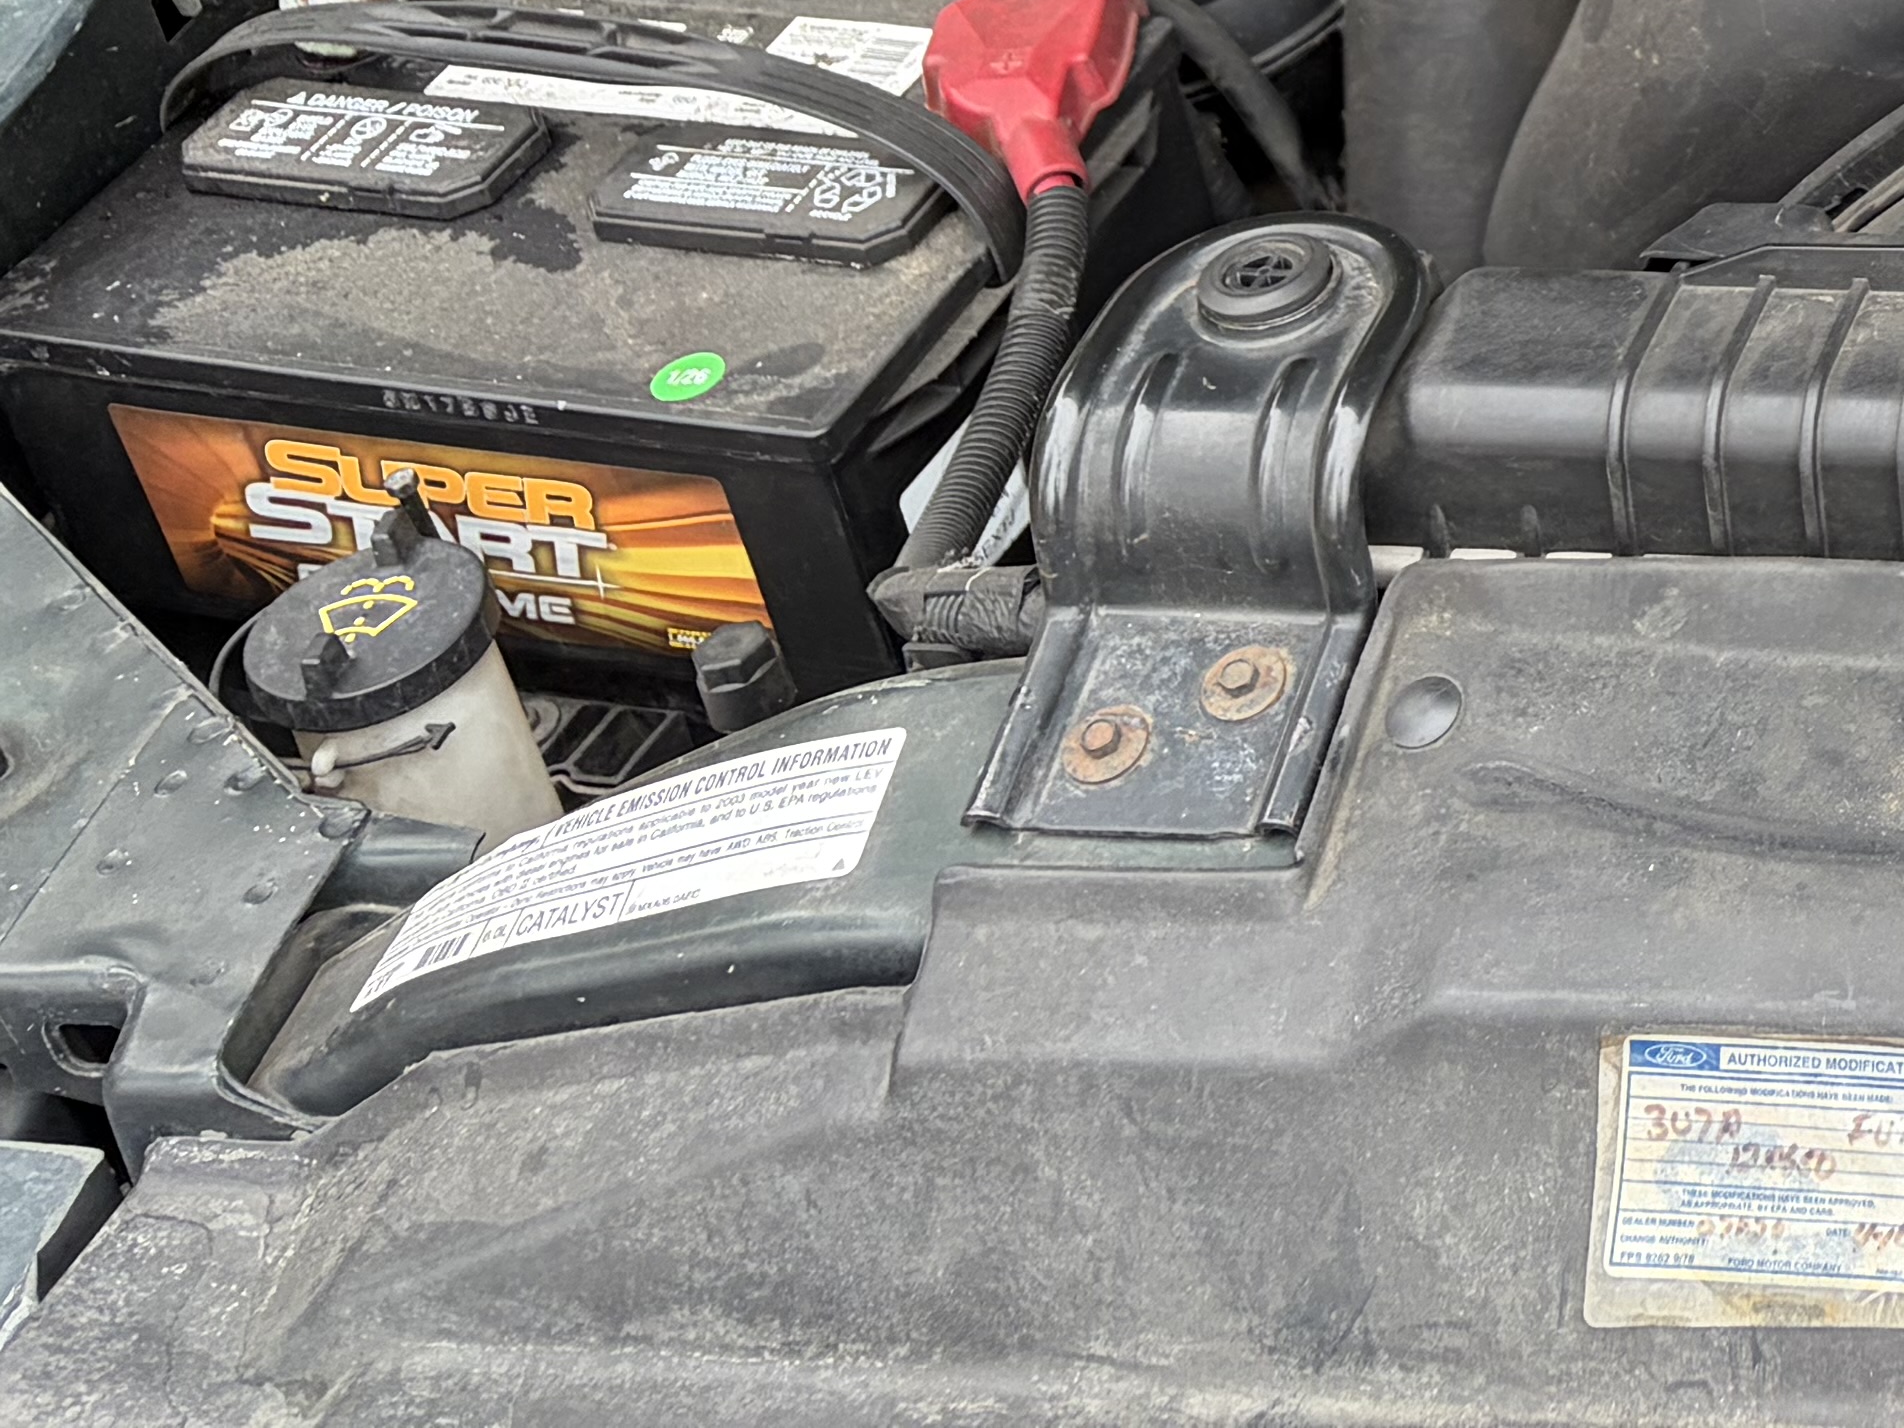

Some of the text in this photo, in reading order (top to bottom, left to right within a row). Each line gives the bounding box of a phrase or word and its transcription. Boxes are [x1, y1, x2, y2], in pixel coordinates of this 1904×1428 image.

[307, 93, 390, 114] DANGER
[402, 102, 480, 123] POISON
[264, 439, 594, 531] SUPER
[553, 737, 893, 839] VEHICLE EMISSION CONTROL INFORMATION
[708, 808, 734, 826] and
[734, 806, 747, 818] to
[778, 793, 805, 809] EPA
[515, 891, 626, 937] CATALYST
[1655, 1043, 1695, 1066] Ford
[1726, 1052, 1822, 1070] AUTHORIZED
[1698, 1084, 1748, 1096] FOLLOWING
[1749, 1087, 1815, 1100] MODIFICATIONS
[1816, 1090, 1839, 1101] HAVE
[1621, 1216, 1658, 1226] DEALER
[1770, 1205, 1788, 1214] EPA
[1789, 1206, 1808, 1215] AND
[1727, 1256, 1843, 1273] FORD MOTOR COMPANY
